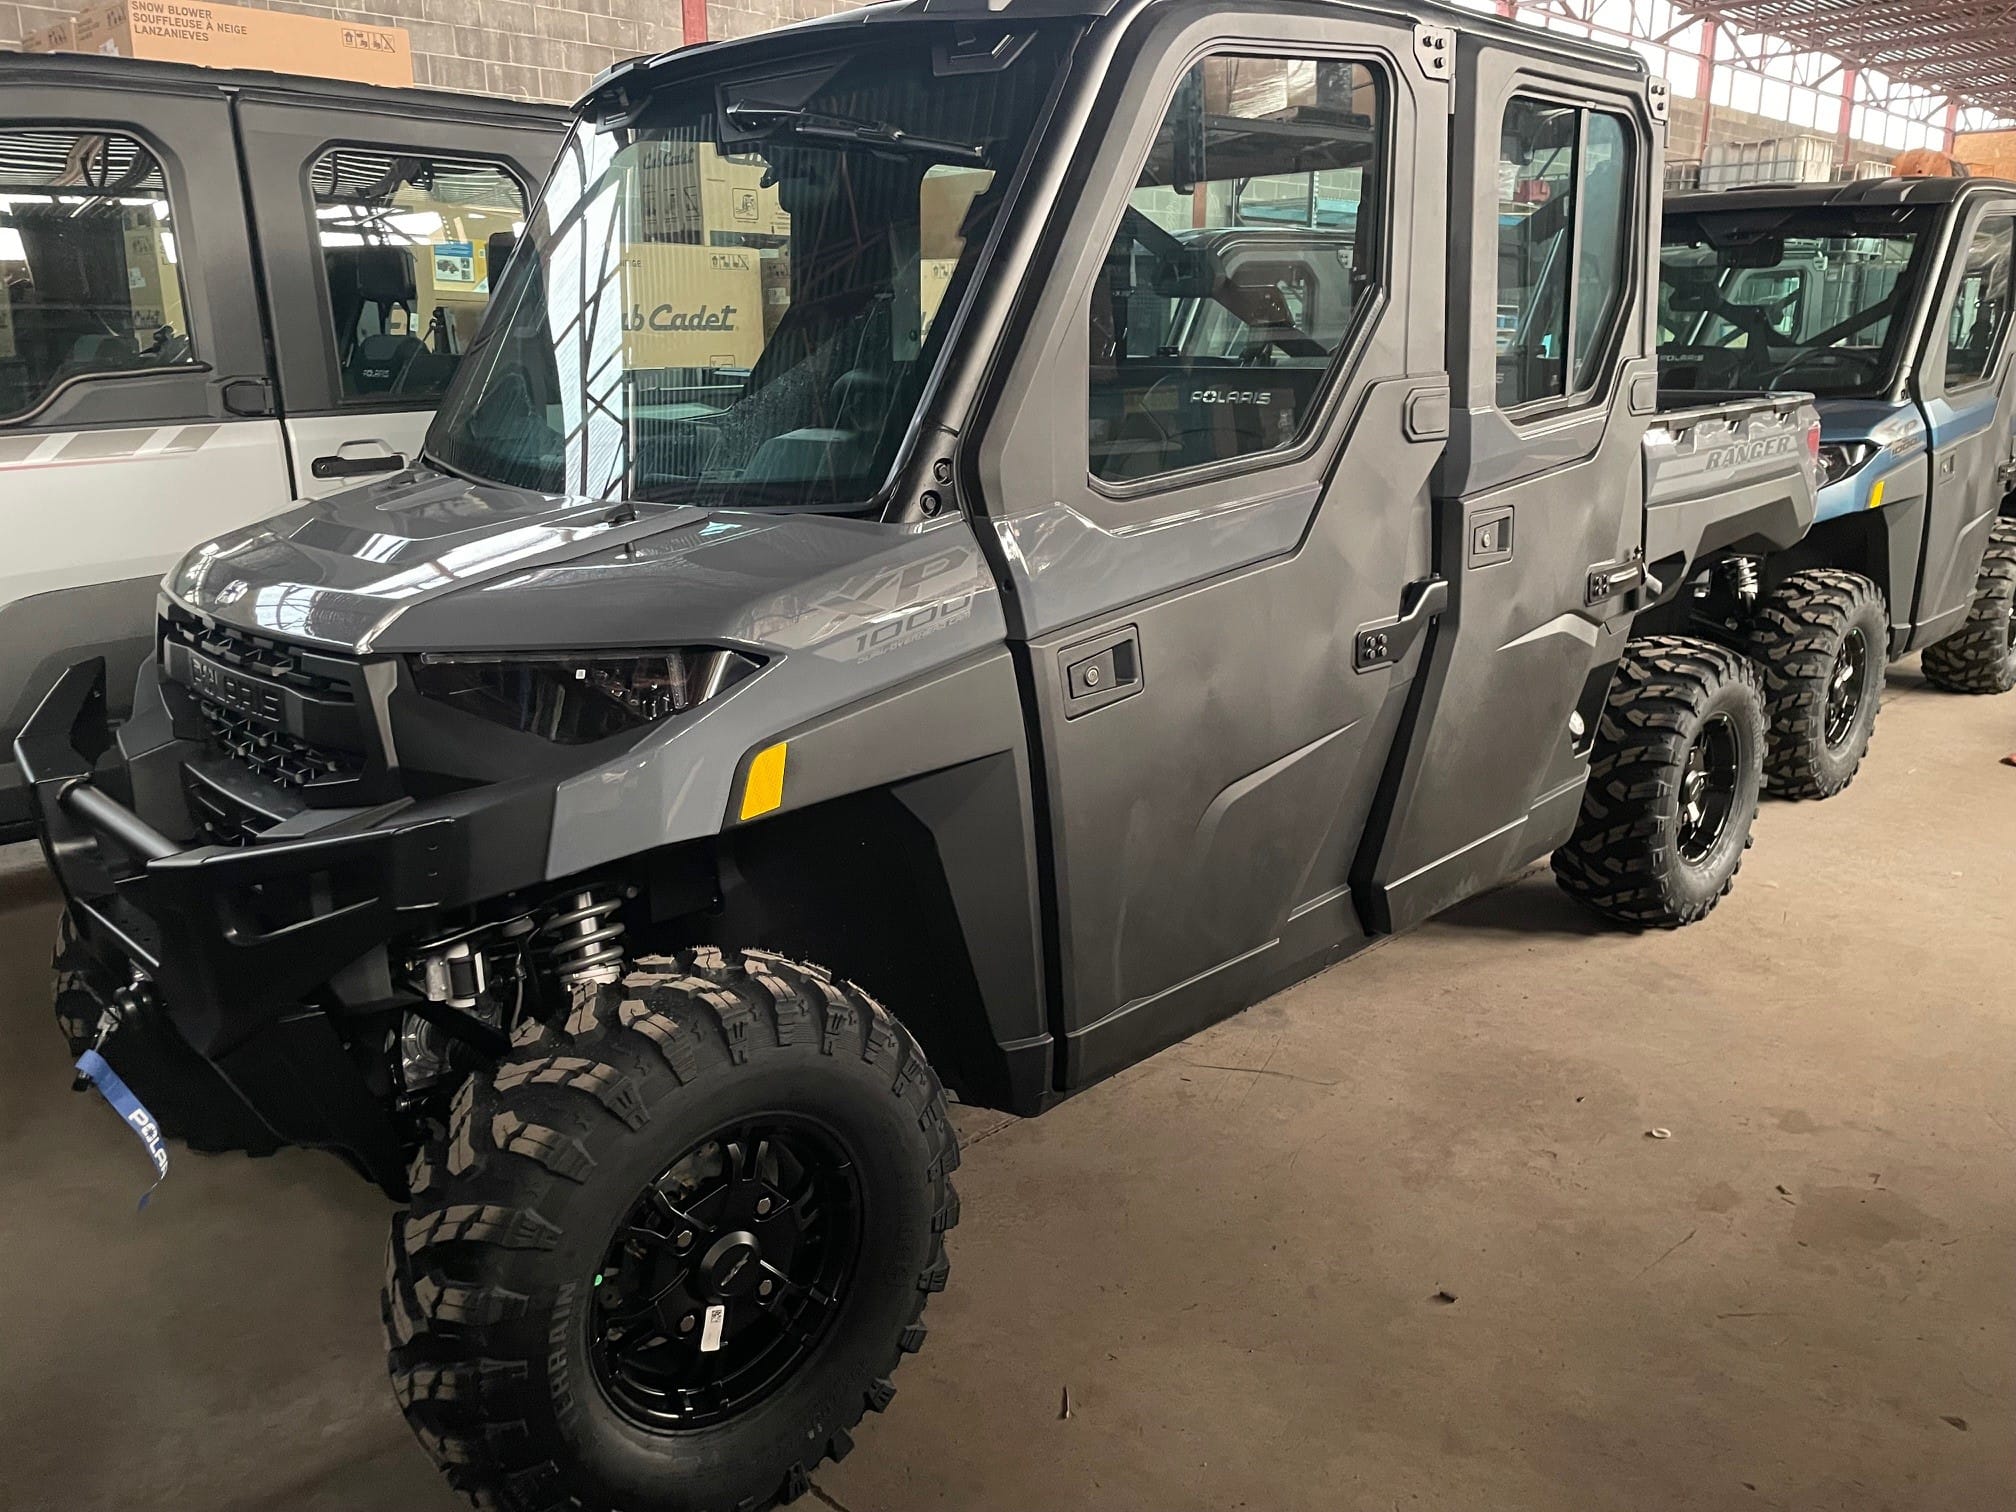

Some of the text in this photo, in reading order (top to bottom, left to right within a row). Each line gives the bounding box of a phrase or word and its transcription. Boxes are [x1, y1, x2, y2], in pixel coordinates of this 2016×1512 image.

[131, 1, 212, 19] SNOW BLOWER
[132, 12, 248, 35] SOUFFLEUSE À NEIGE
[134, 24, 209, 42] LANZANIEVES
[622, 304, 737, 331] ub Cadet
[1190, 390, 1272, 405] POLARIS
[1706, 434, 1791, 470] RANGER
[857, 594, 972, 653] 1000
